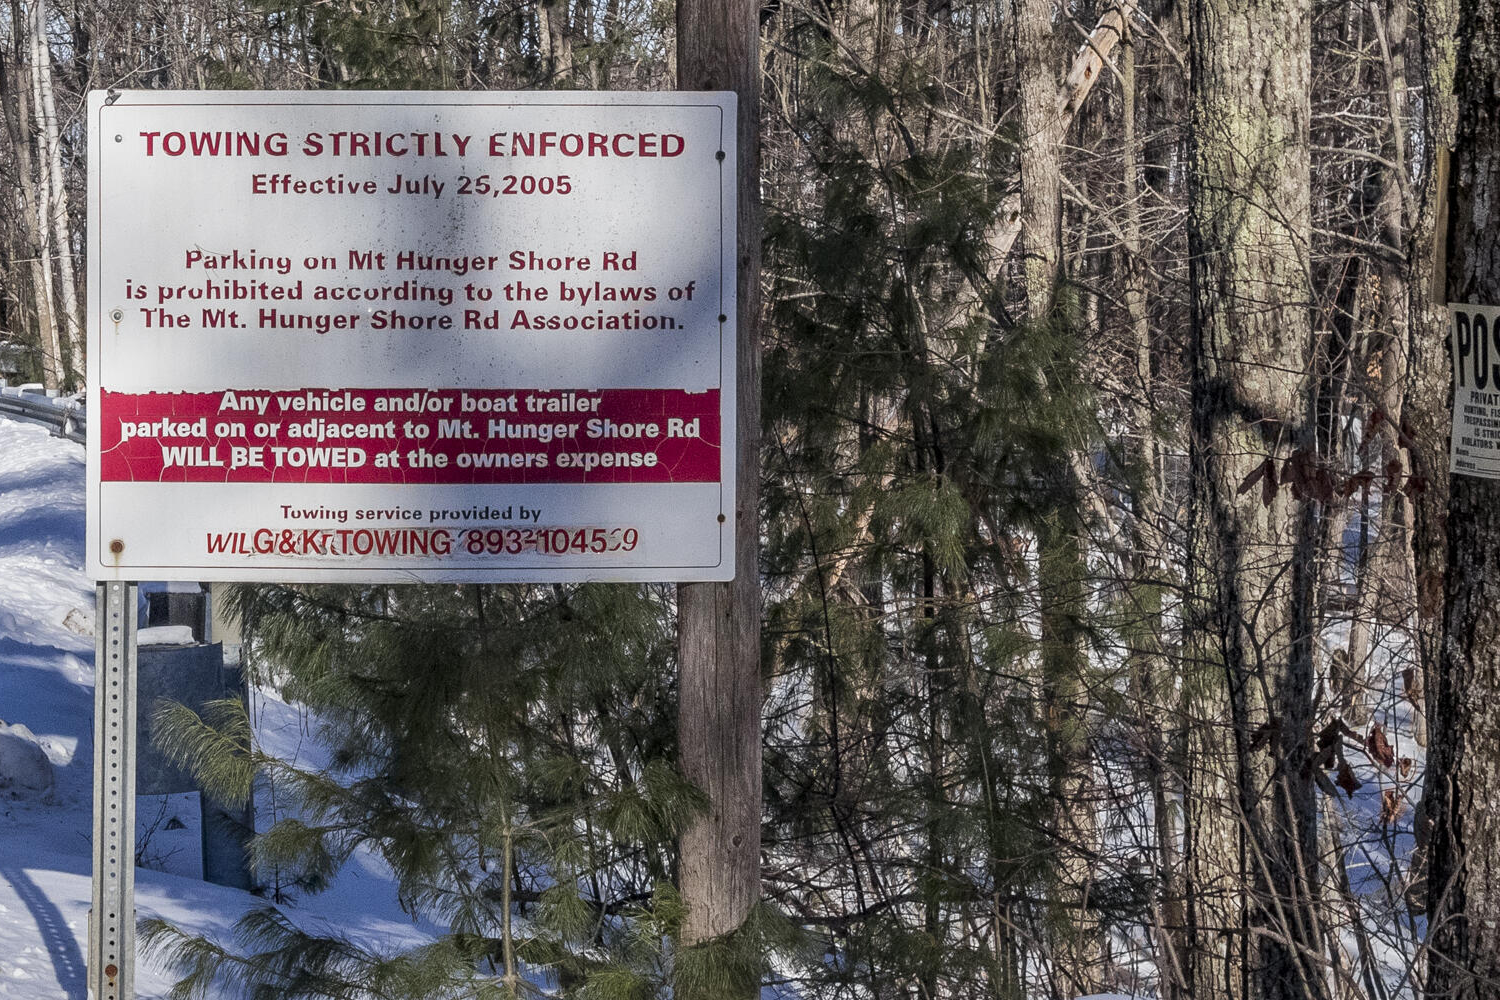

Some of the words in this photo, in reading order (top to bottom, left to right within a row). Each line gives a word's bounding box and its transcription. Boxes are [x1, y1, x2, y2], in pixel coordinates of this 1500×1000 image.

[140, 131, 290, 157] TOWING
[302, 131, 472, 158] STRICTLY
[488, 131, 686, 158] ENFORCED
[252, 174, 378, 195] Effective
[387, 174, 445, 200] July
[185, 249, 292, 275] Parking
[303, 255, 337, 271] on
[348, 249, 386, 271] Mt
[396, 249, 499, 277] Hunger
[508, 250, 591, 272] Shore
[602, 250, 637, 272] Rd
[126, 278, 148, 300] is
[158, 278, 303, 305] prohibited
[313, 279, 454, 306] according
[463, 282, 493, 302] to
[503, 280, 549, 302] the
[559, 280, 657, 306] bylaws
[667, 280, 697, 302] of
[140, 307, 191, 329] The
[202, 307, 247, 329] Mt.
[258, 307, 360, 335] Hunger
[370, 308, 453, 331] Shore
[463, 308, 500, 331] Rd
[509, 308, 685, 332] Association.
[219, 391, 270, 415] Any
[277, 391, 366, 412] vehicle
[374, 391, 453, 413] and/or
[461, 393, 519, 413] boat
[526, 392, 602, 413] trailer
[121, 417, 207, 442] parked
[214, 422, 246, 439] on
[253, 422, 282, 438] or
[287, 418, 396, 443] adjacent
[402, 420, 430, 439] to
[437, 419, 480, 439] Mt.
[487, 419, 579, 443] Hunger
[586, 418, 660, 438] Shore
[667, 418, 700, 438] Rd
[161, 446, 224, 467] WILL
[231, 447, 264, 469] BE
[271, 447, 367, 468] TOWED
[374, 450, 400, 468] at
[406, 447, 449, 468] the
[456, 452, 549, 468] owners
[556, 452, 658, 472] expense
[280, 505, 349, 524] Towing
[355, 505, 423, 521] service
[429, 505, 513, 524] provided
[519, 505, 542, 524] by
